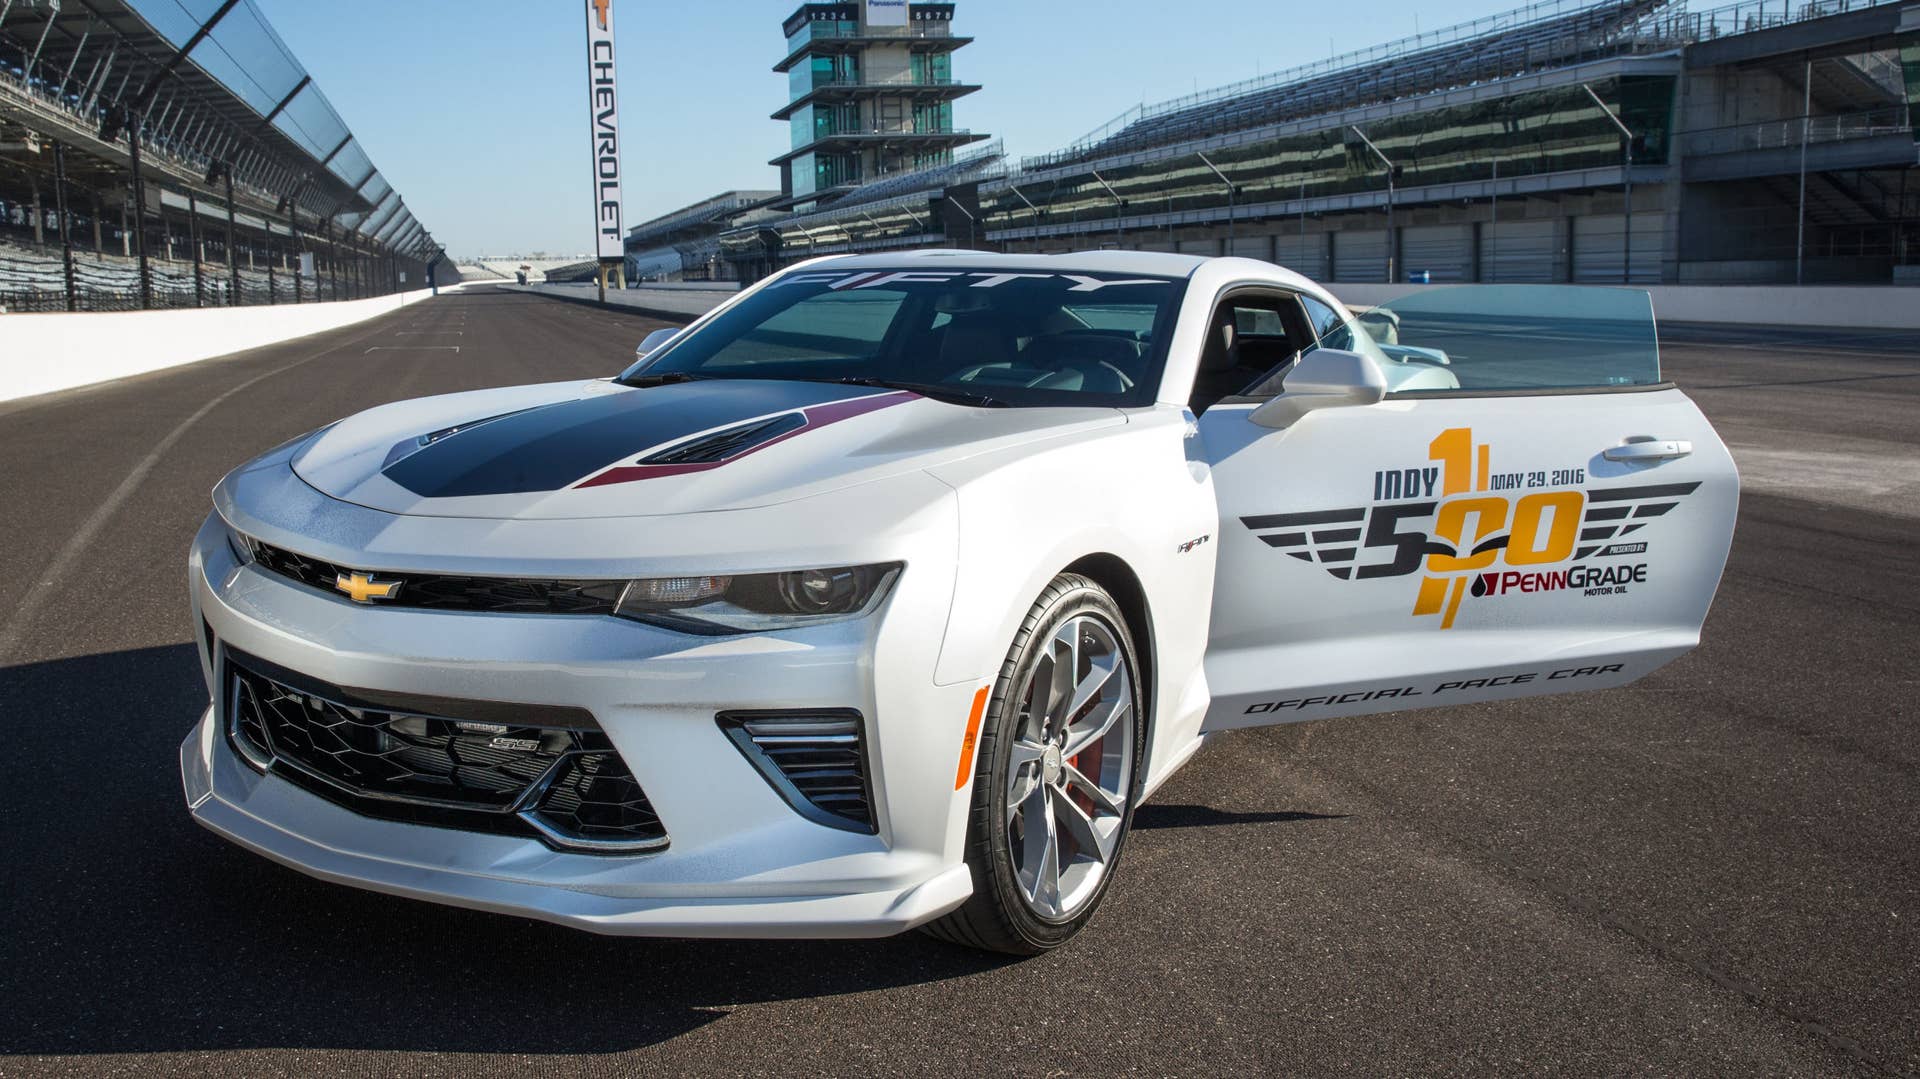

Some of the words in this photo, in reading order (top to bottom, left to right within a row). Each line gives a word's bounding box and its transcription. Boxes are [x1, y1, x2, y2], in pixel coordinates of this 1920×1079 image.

[593, 40, 621, 242] CHEVROLET
[772, 271, 1171, 292] FIFTY
[1374, 467, 1438, 500] INDY
[1491, 473, 1524, 490] MAY
[1527, 471, 1549, 488] 29,
[1552, 468, 1585, 486] 2016
[1356, 490, 1584, 580] 500
[1501, 563, 1648, 595] PENNGRADE
[1584, 586, 1612, 597] MOTOR
[1615, 585, 1628, 594] OIL
[1244, 686, 1422, 715] OFFICIAL
[1432, 672, 1539, 695] PACE
[1548, 663, 1624, 682] CAR
